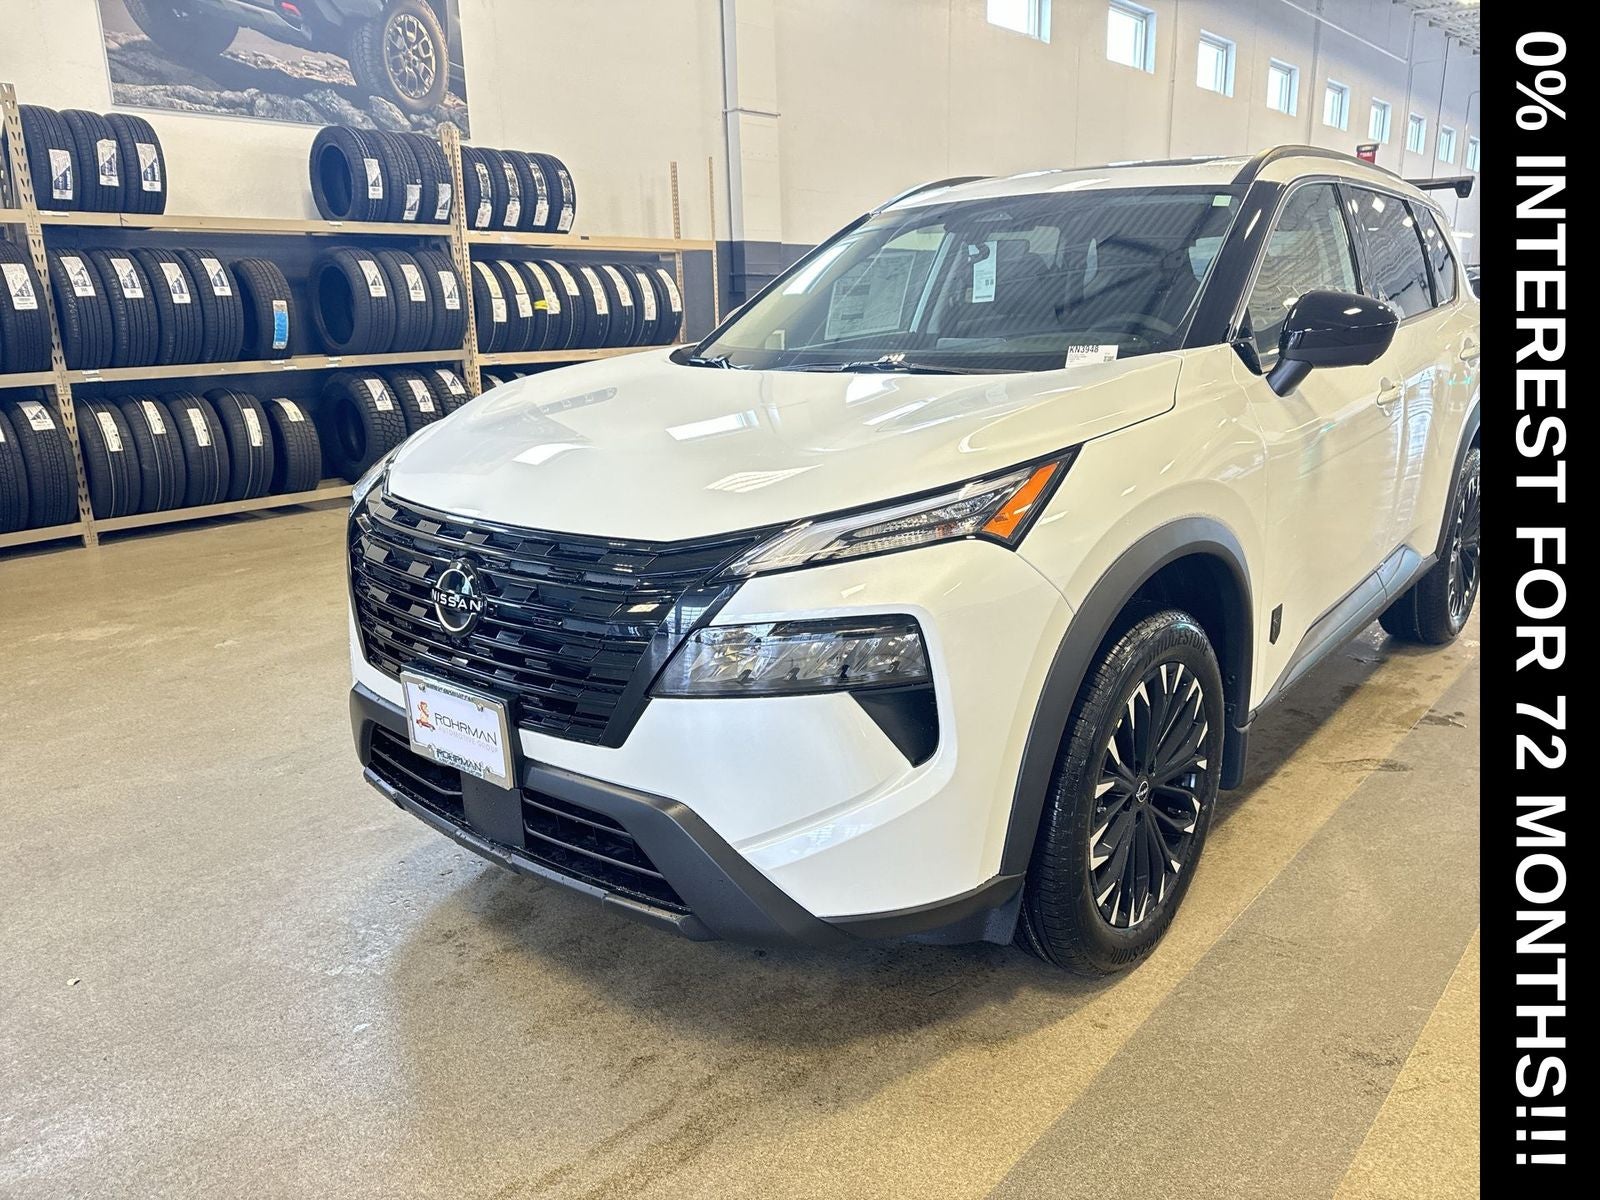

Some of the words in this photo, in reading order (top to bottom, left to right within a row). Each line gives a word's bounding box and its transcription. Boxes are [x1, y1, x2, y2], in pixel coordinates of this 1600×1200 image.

[1069, 345, 1099, 353] KN3948
[431, 588, 481, 611] NISSAN
[434, 712, 497, 746] ROHRMAN
